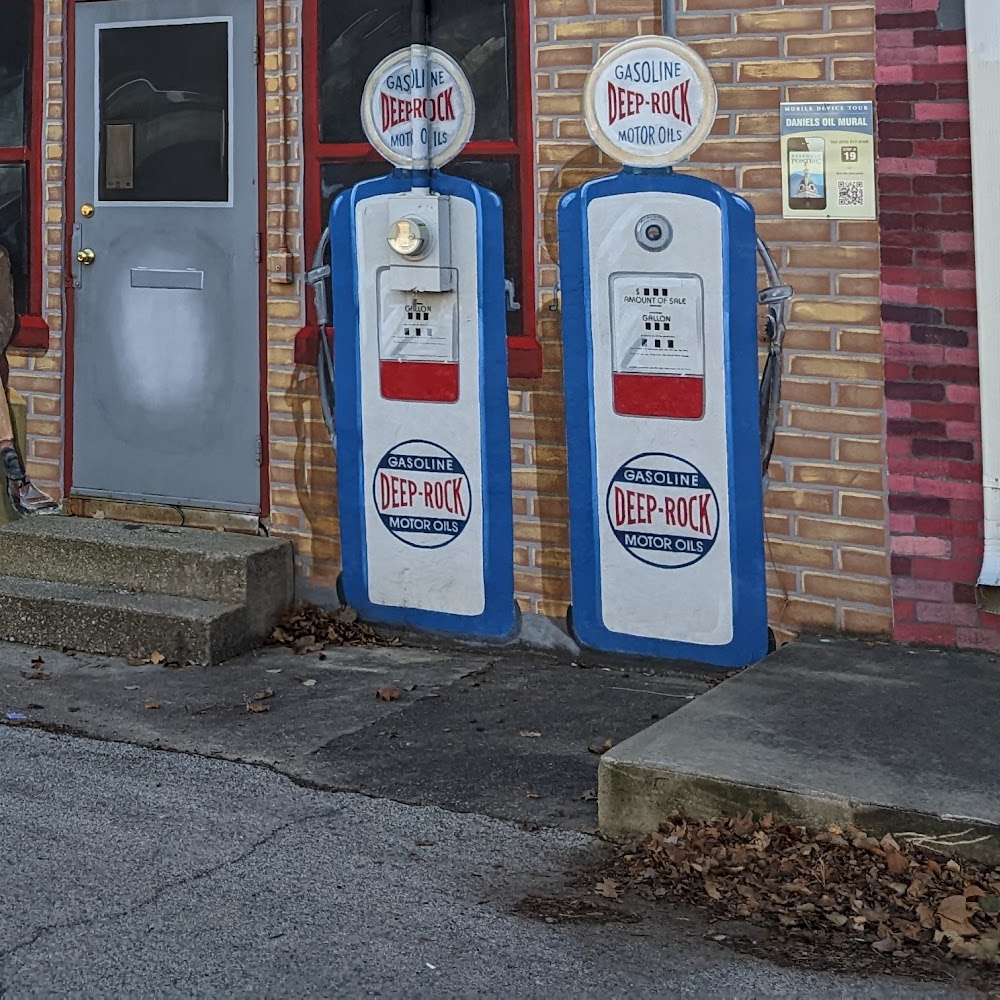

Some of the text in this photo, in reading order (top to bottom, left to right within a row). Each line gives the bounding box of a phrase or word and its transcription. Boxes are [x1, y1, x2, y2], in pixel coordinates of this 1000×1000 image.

[615, 60, 681, 84] GASOLINE
[607, 78, 692, 127] DEEP-ROCK
[786, 117, 868, 127] DANIELS OIL MURAL
[618, 125, 682, 145] MOTOR OILS
[844, 152, 857, 161] 19
[624, 296, 655, 304] AMOUNT
[669, 297, 687, 305] SALE
[388, 456, 454, 471] GASOLINE
[623, 469, 699, 487] GASOLINE
[380, 472, 465, 517] DEEP-ROCK
[614, 486, 712, 536] DEEP-ROCK
[389, 516, 459, 533] MOTOR OILS
[624, 533, 704, 553] MOTOR OILS
